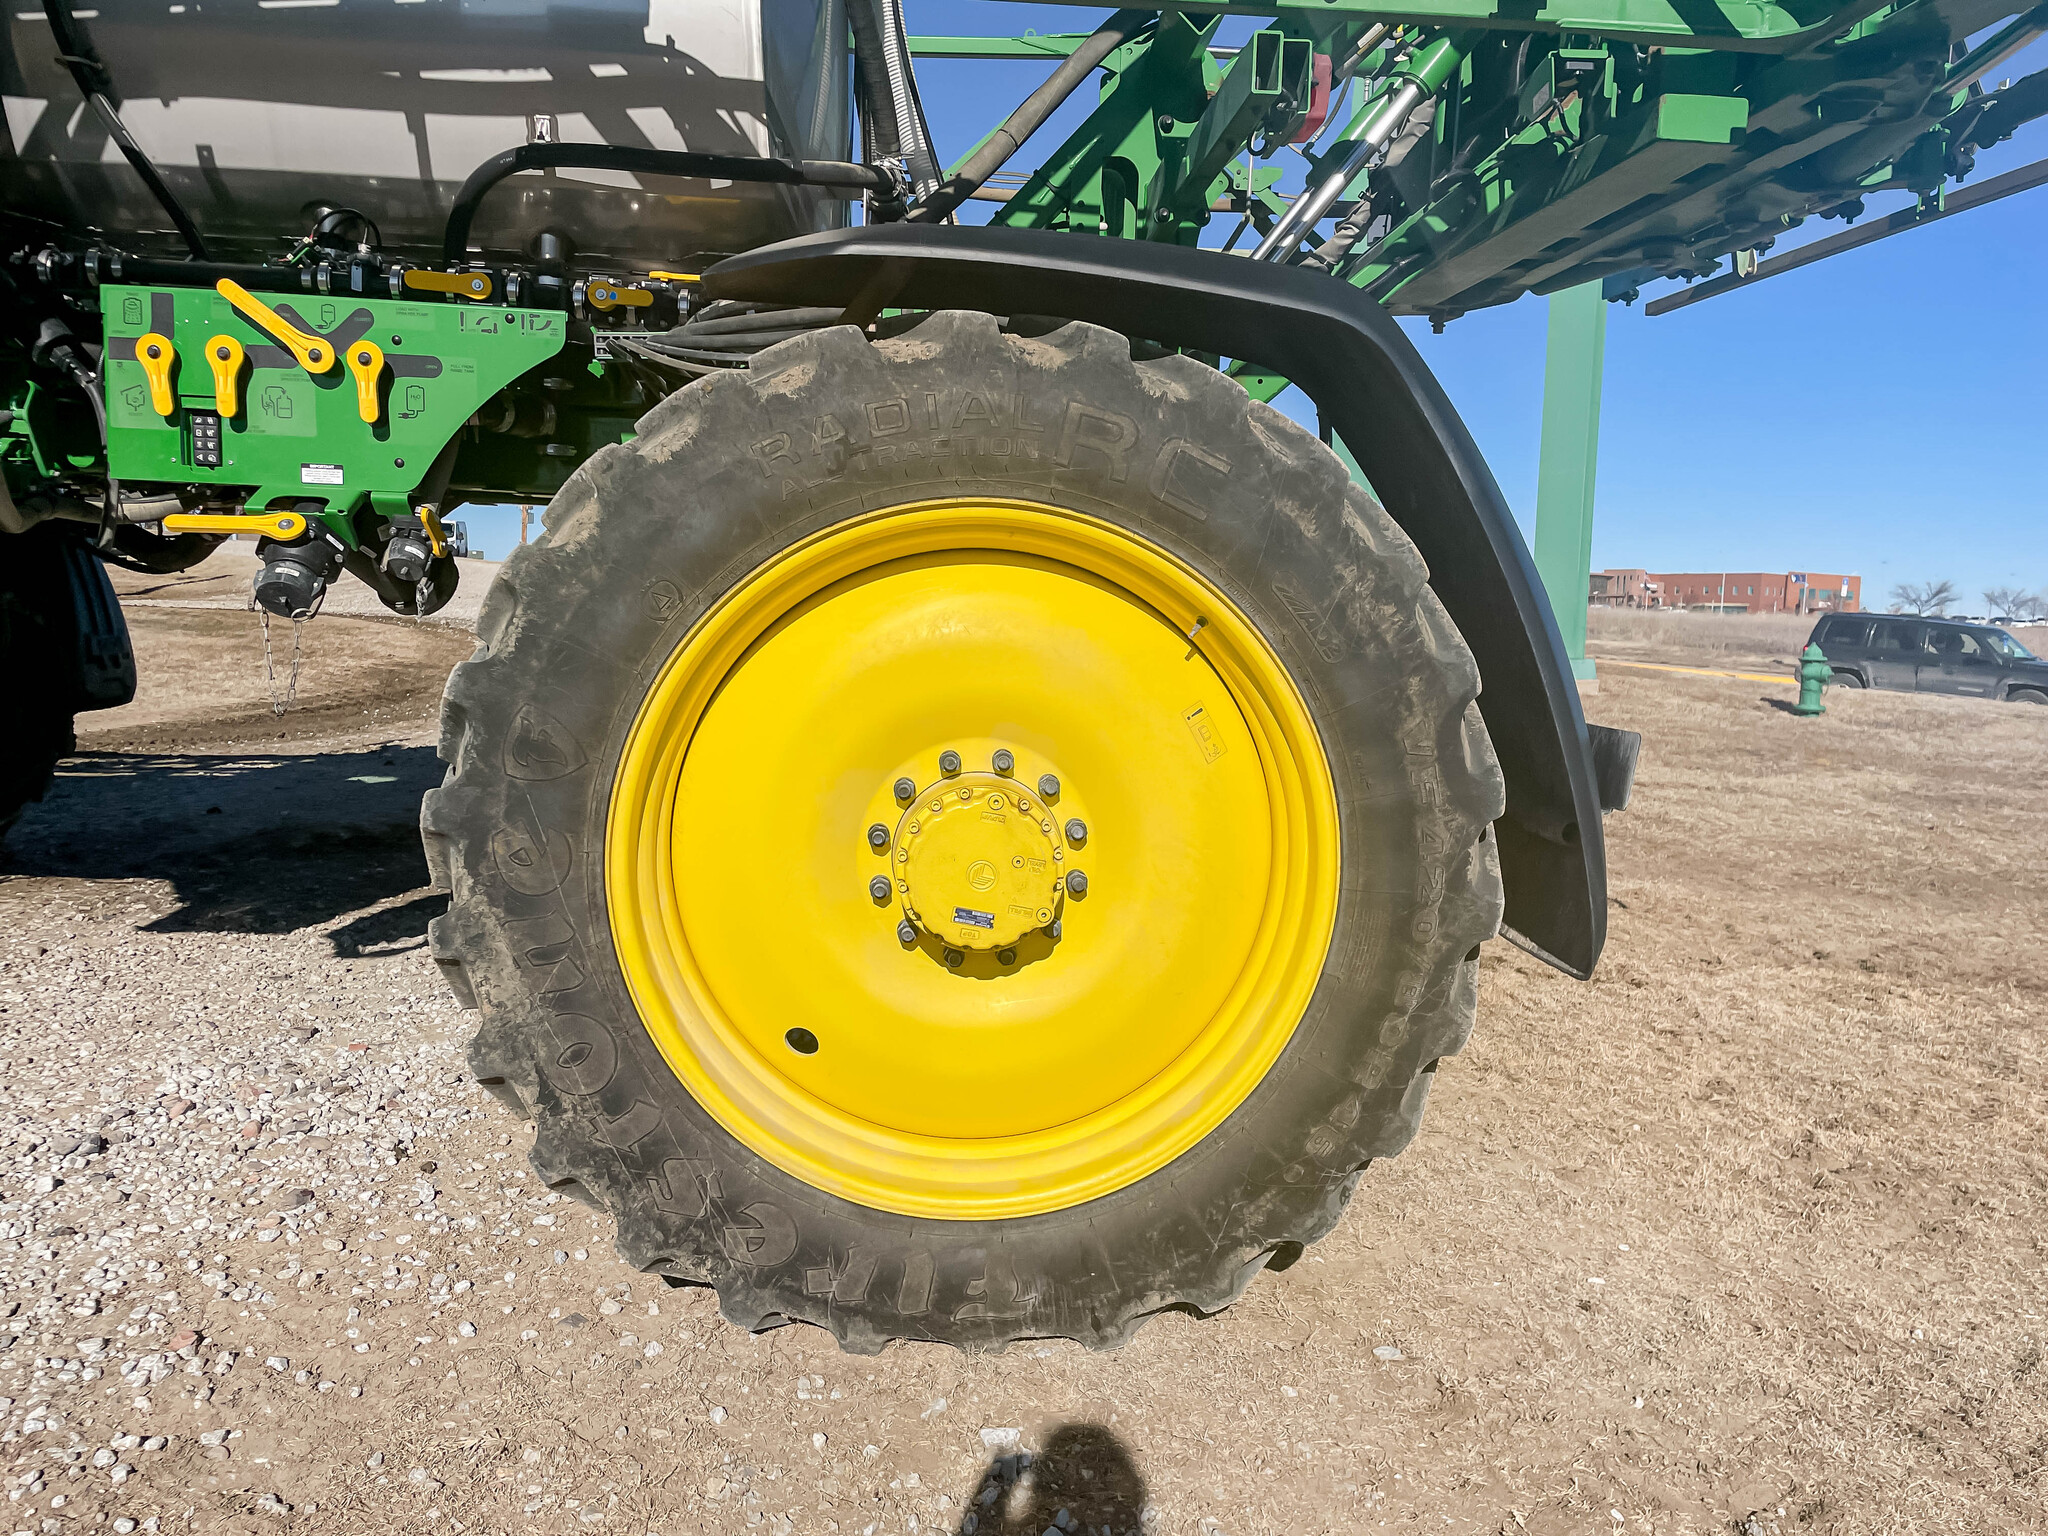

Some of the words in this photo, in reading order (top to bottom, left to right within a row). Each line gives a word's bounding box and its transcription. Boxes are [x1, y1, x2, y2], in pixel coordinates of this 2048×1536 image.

[749, 391, 1046, 478] RADIAL
[1053, 395, 1235, 524] RC
[852, 434, 1039, 475] TRACTION
[962, 930, 979, 938] TOP
[491, 818, 1038, 1323] Firestone
